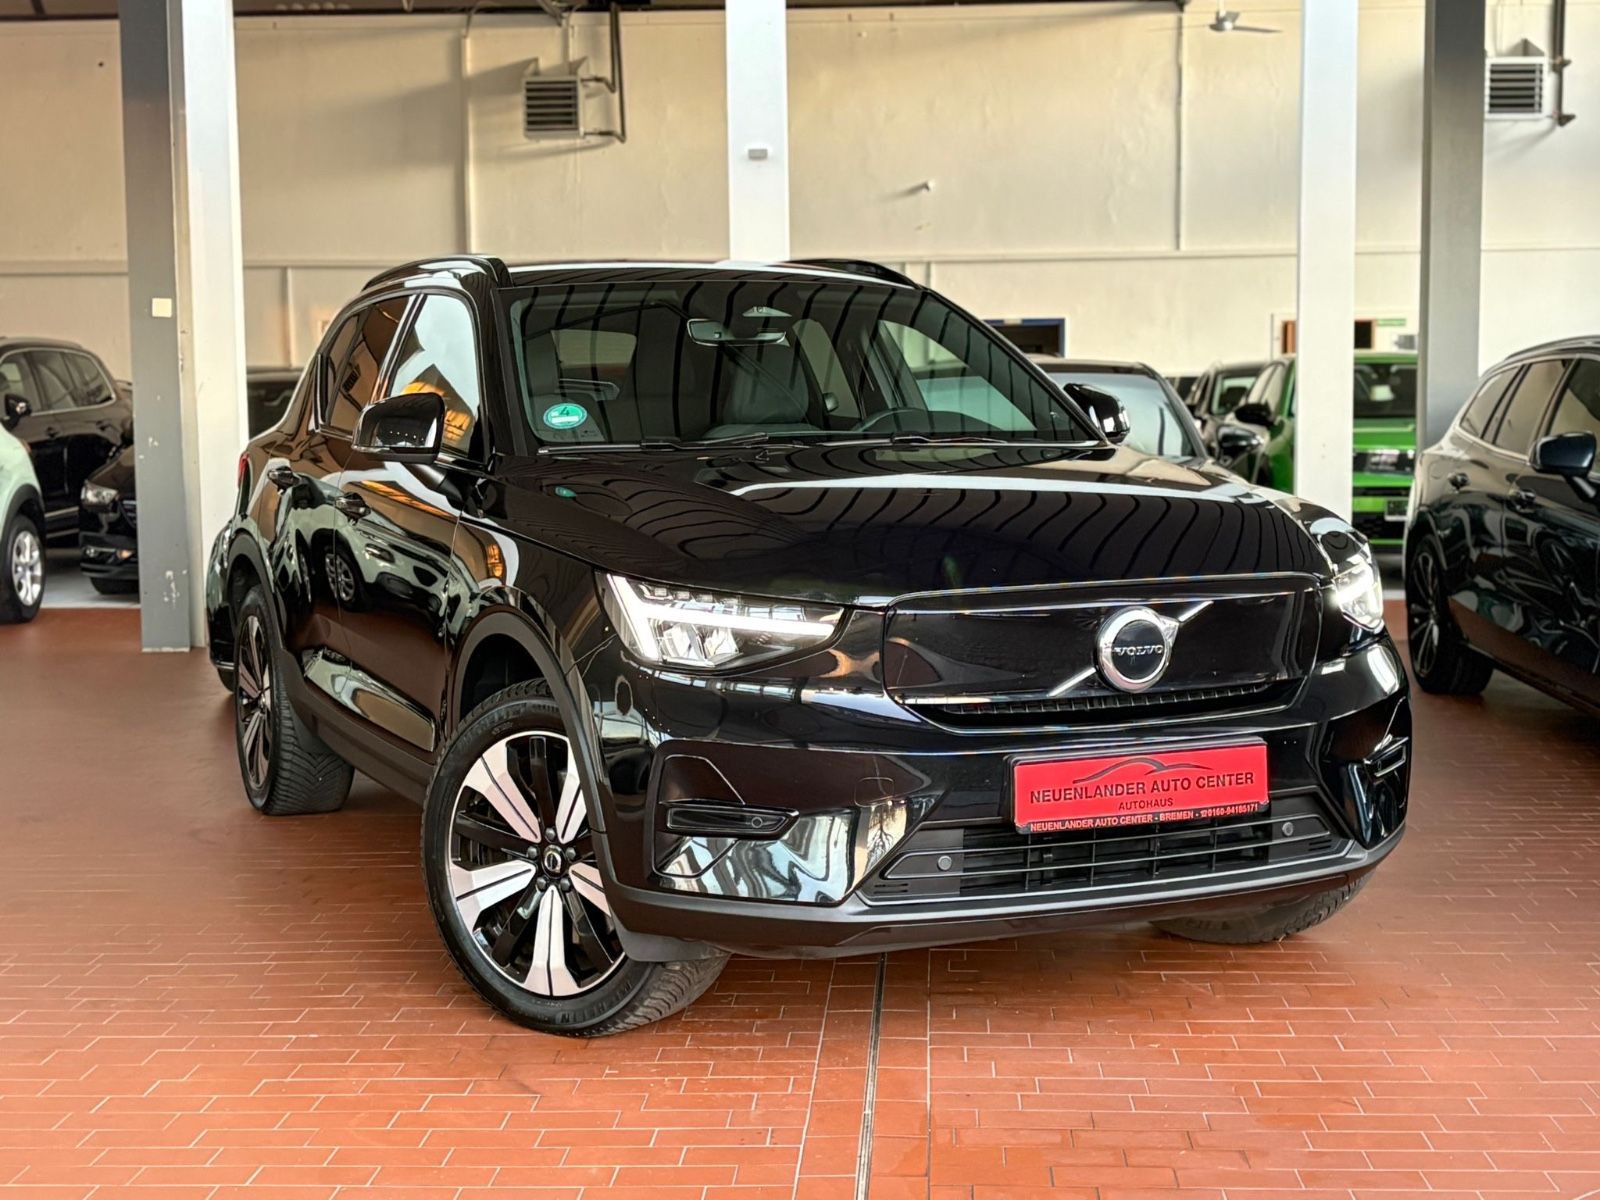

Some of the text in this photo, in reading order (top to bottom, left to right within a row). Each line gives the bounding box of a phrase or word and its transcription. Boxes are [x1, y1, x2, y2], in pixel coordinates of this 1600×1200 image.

[560, 406, 570, 416] 4
[1114, 645, 1164, 656] VOLVO
[1030, 772, 1254, 804] NEUENLANDER AUTO CENTER
[1118, 798, 1174, 811] AUTOHAUS
[1030, 819, 1094, 832] NEUENLANDER
[1095, 817, 1118, 827] AUTO
[1119, 814, 1153, 825] CENTER
[1160, 811, 1194, 821] BREMEN
